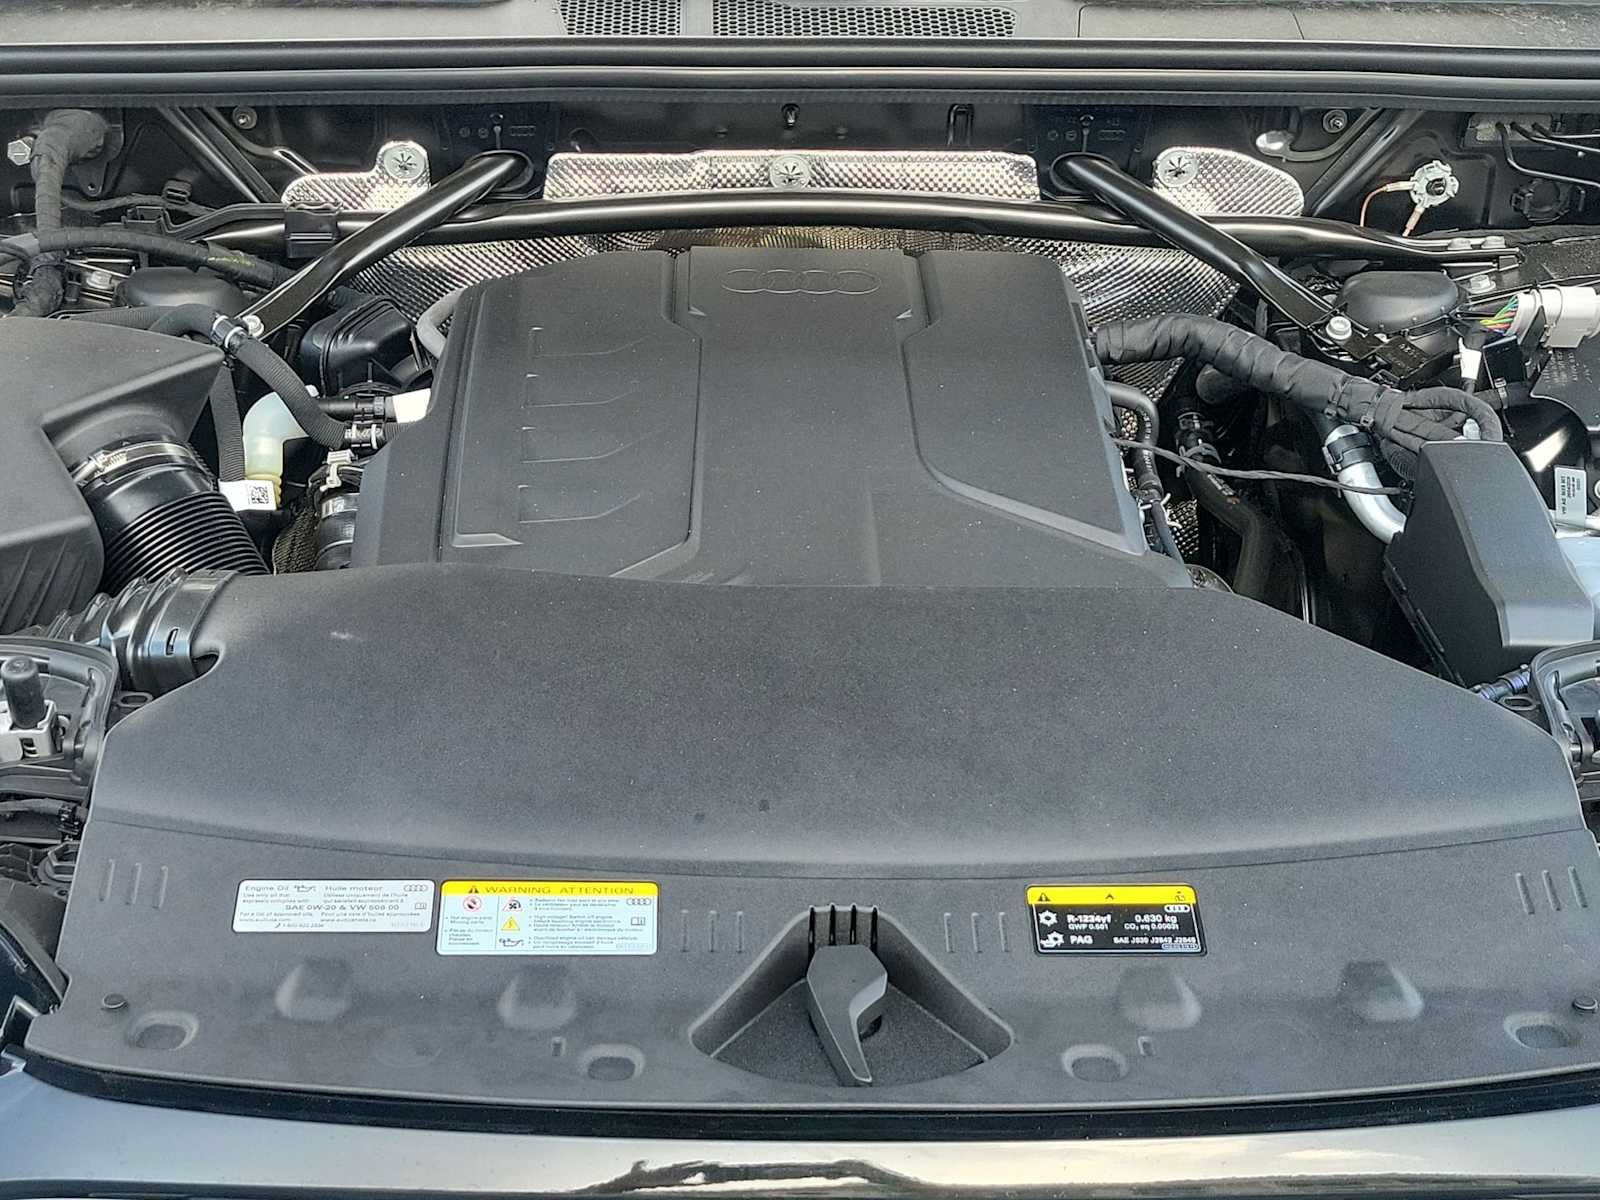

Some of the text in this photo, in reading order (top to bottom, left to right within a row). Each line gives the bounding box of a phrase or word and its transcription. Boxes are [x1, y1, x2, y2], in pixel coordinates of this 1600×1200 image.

[485, 886, 551, 894] WARNING
[559, 886, 635, 895] ATTENTION
[1067, 914, 1112, 924] R-1234yf
[1134, 914, 1178, 924] 0.630 kg
[1070, 934, 1094, 945] PAG
